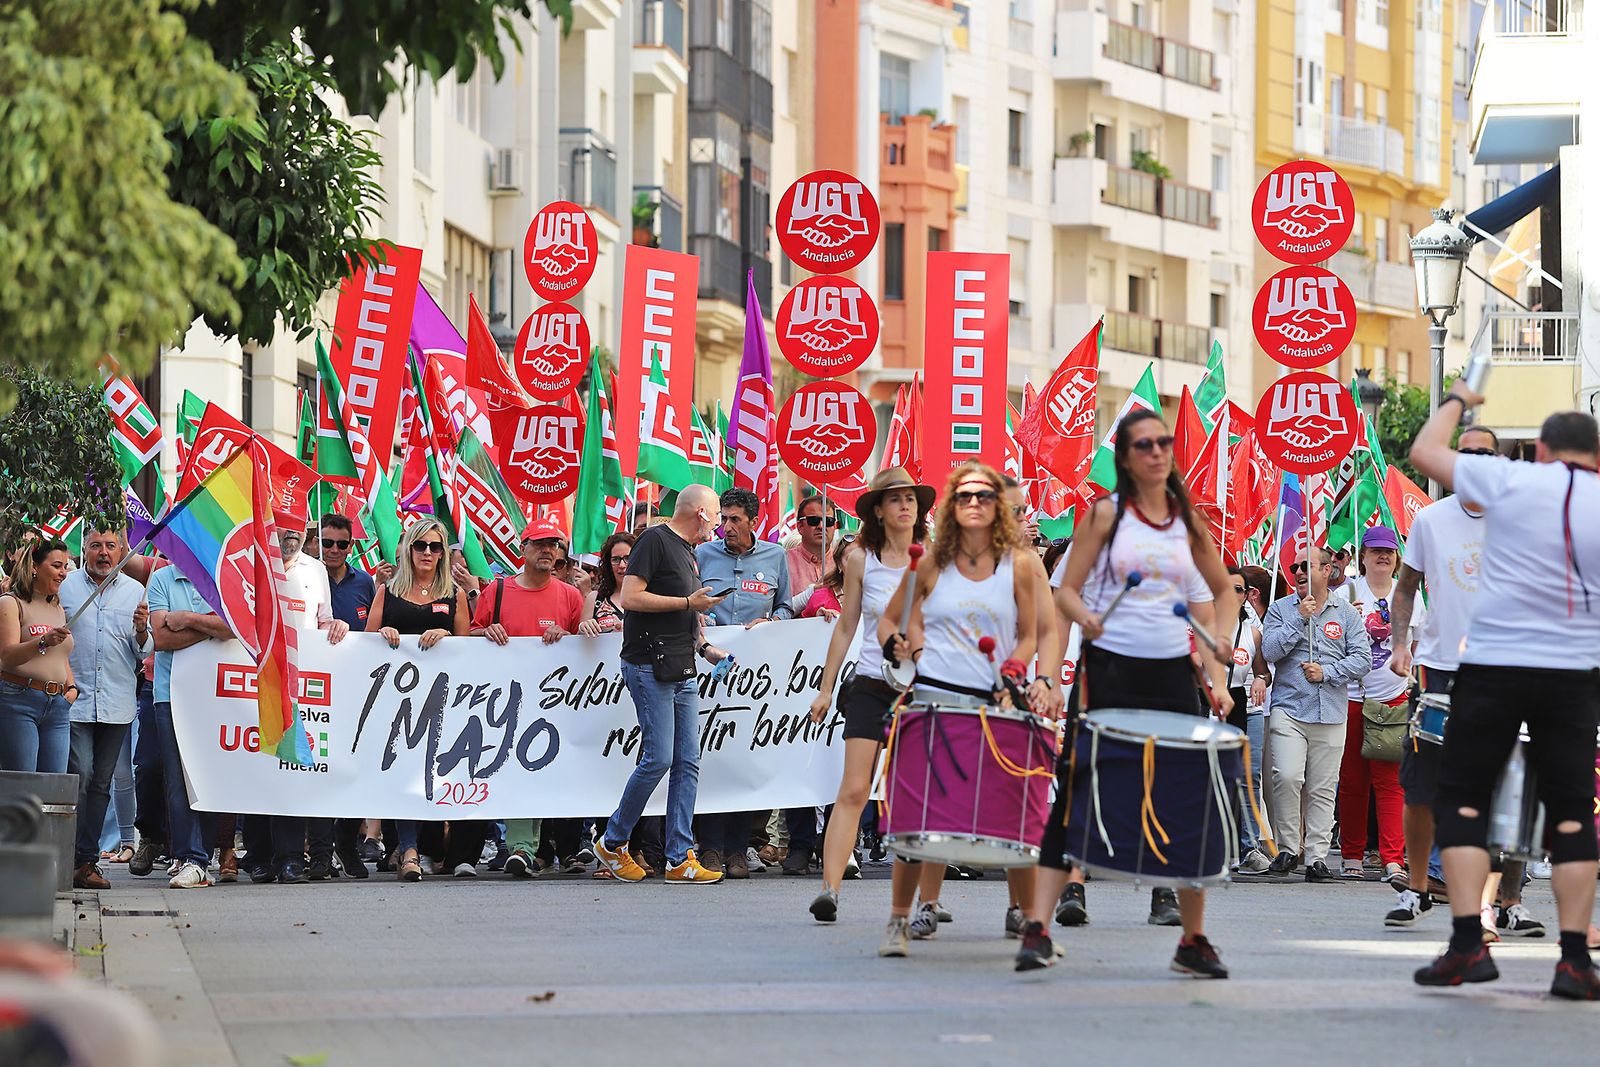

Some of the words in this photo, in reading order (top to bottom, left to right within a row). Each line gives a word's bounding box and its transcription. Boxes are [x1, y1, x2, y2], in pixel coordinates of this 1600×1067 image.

[791, 182, 863, 218] UGT
[1266, 172, 1337, 208] UGT
[535, 212, 586, 248] UGT
[801, 248, 855, 263] Andalucía
[1277, 238, 1332, 253] Andalucía
[538, 276, 578, 291] Andalucía
[1267, 277, 1338, 313] UGT
[789, 287, 862, 323] UGT
[526, 313, 581, 349] UGT
[952, 271, 985, 415] CCOO
[799, 351, 853, 366] Andalucía
[1278, 343, 1334, 358] Andalucía
[530, 376, 570, 392] Andalucía
[1048, 371, 1096, 424] UGT
[790, 391, 859, 427] UGT
[1270, 382, 1341, 418] UGT
[514, 415, 578, 451] UGT
[798, 456, 852, 471] Andalucía
[1281, 449, 1335, 464] Andalucía
[519, 479, 568, 494] Andalucía
[741, 582, 760, 591] UGT
[30, 626, 48, 635] UGT
[451, 683, 490, 709] DE
[219, 724, 260, 753] UG
[381, 672, 560, 801] MAYO
[436, 782, 490, 806] 2023
